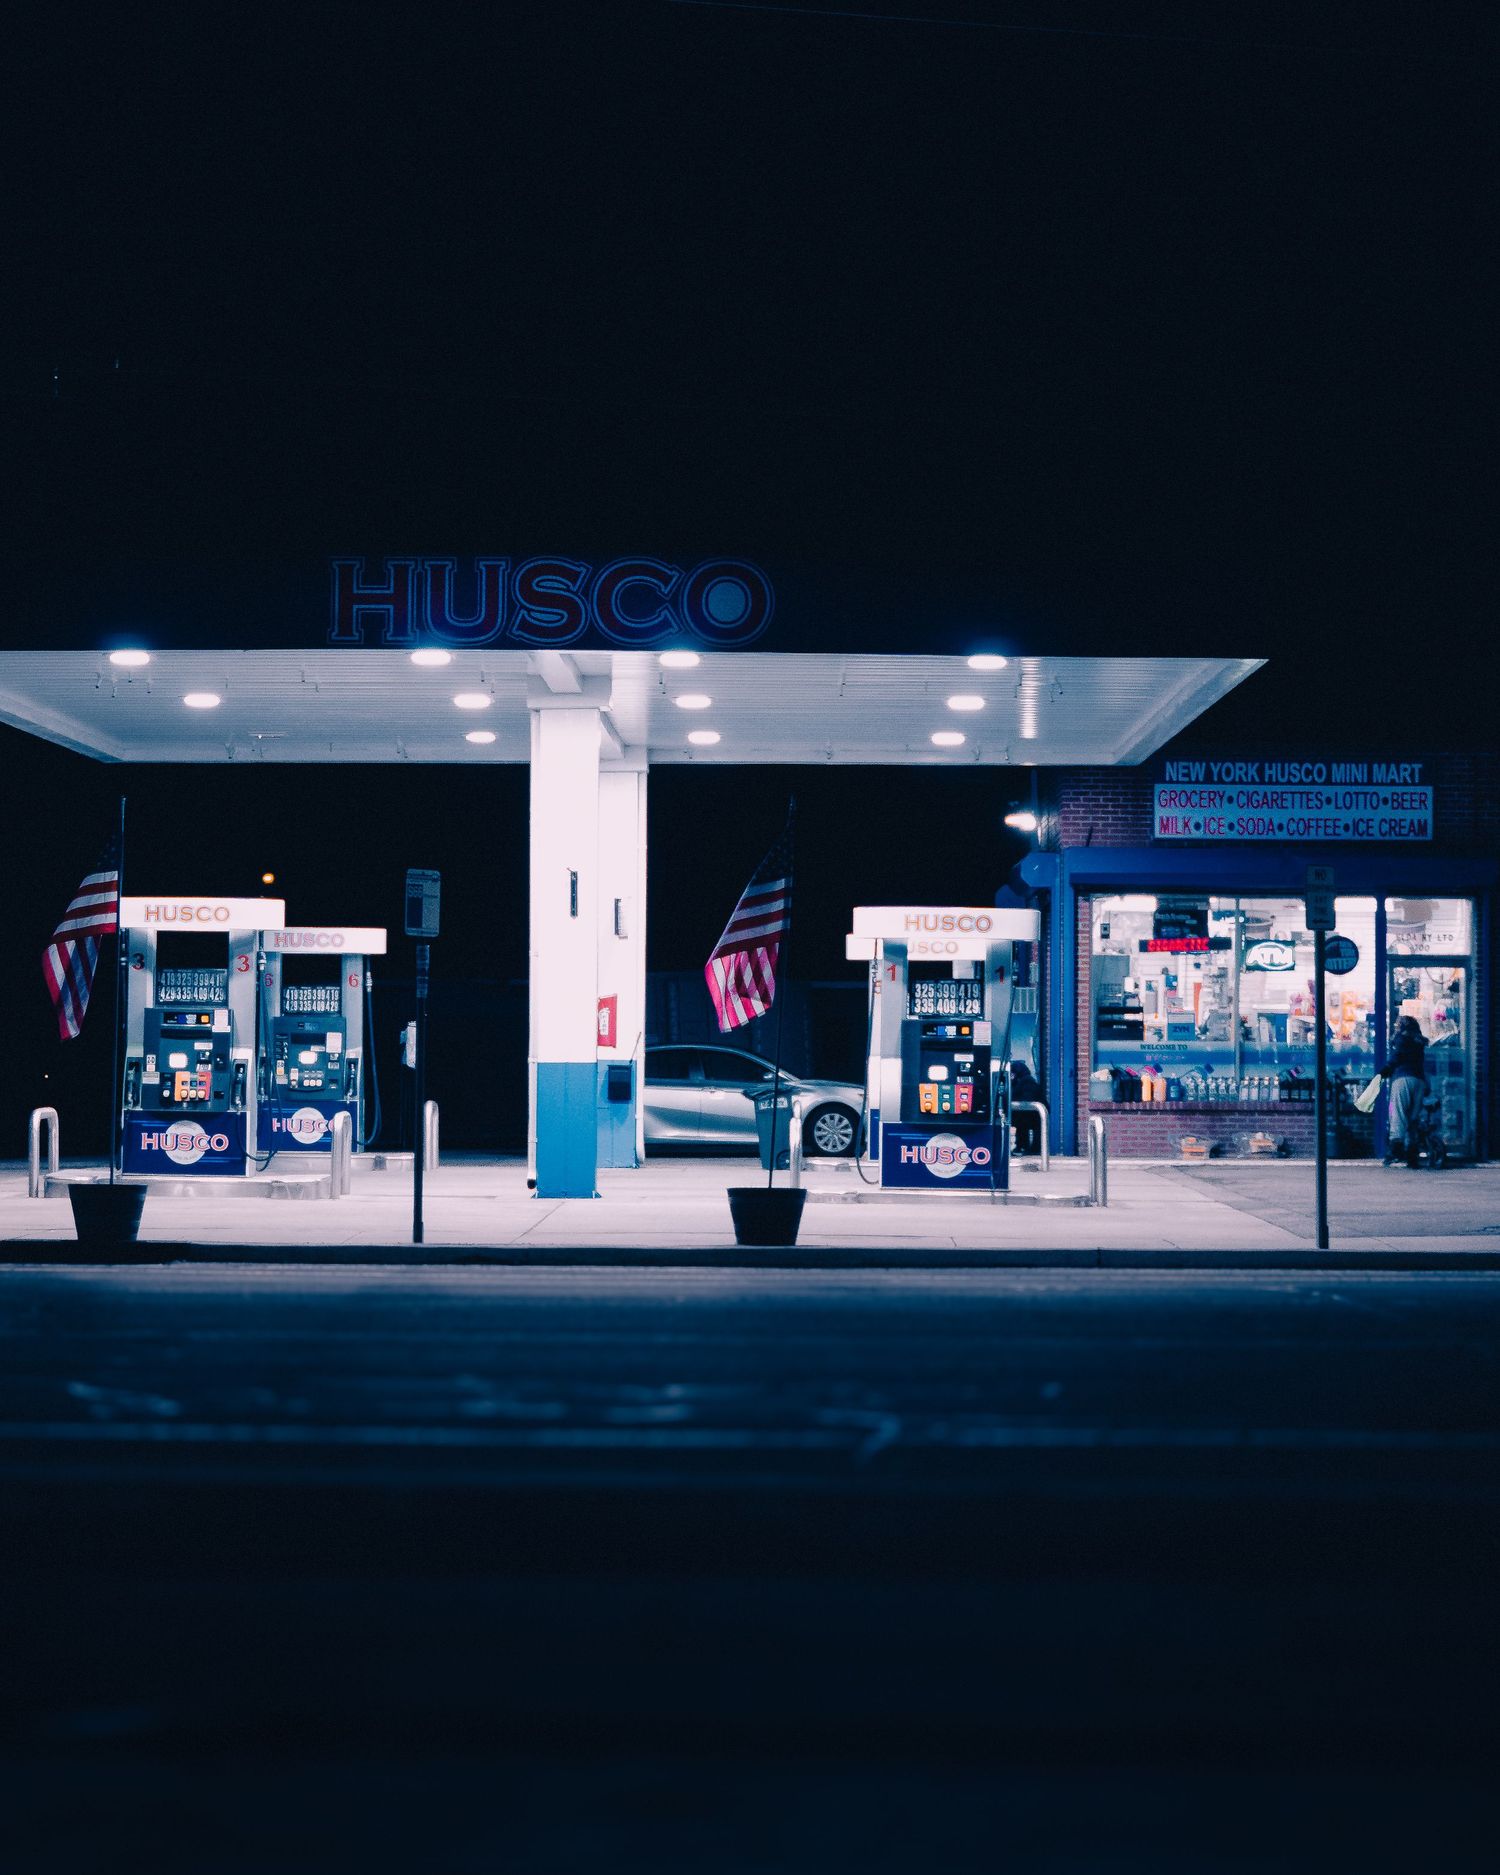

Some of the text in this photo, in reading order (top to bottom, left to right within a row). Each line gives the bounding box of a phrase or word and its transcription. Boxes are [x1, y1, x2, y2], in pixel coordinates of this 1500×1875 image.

[328, 556, 776, 647] HUSCO
[1165, 762, 1424, 784] NEW YORK HUSCO MINI MART
[1158, 789, 1429, 811] GROCERY CIGARETTES LOTTO BEER
[1159, 816, 1429, 838] MILK ICE SODA COFFEE ICE CREAM
[144, 904, 231, 923] HUSCO
[905, 913, 993, 933] HUSCO
[273, 932, 345, 949] HUSCO
[132, 952, 146, 971] 3
[237, 953, 250, 973] 3
[1246, 946, 1293, 966] ATM
[348, 973, 359, 988] 6
[886, 963, 897, 982] 1
[994, 966, 1004, 984] 1
[1140, 1043, 1176, 1051] WELCOME
[141, 1132, 230, 1152] HUSCO
[901, 1145, 991, 1165] HUSCO
